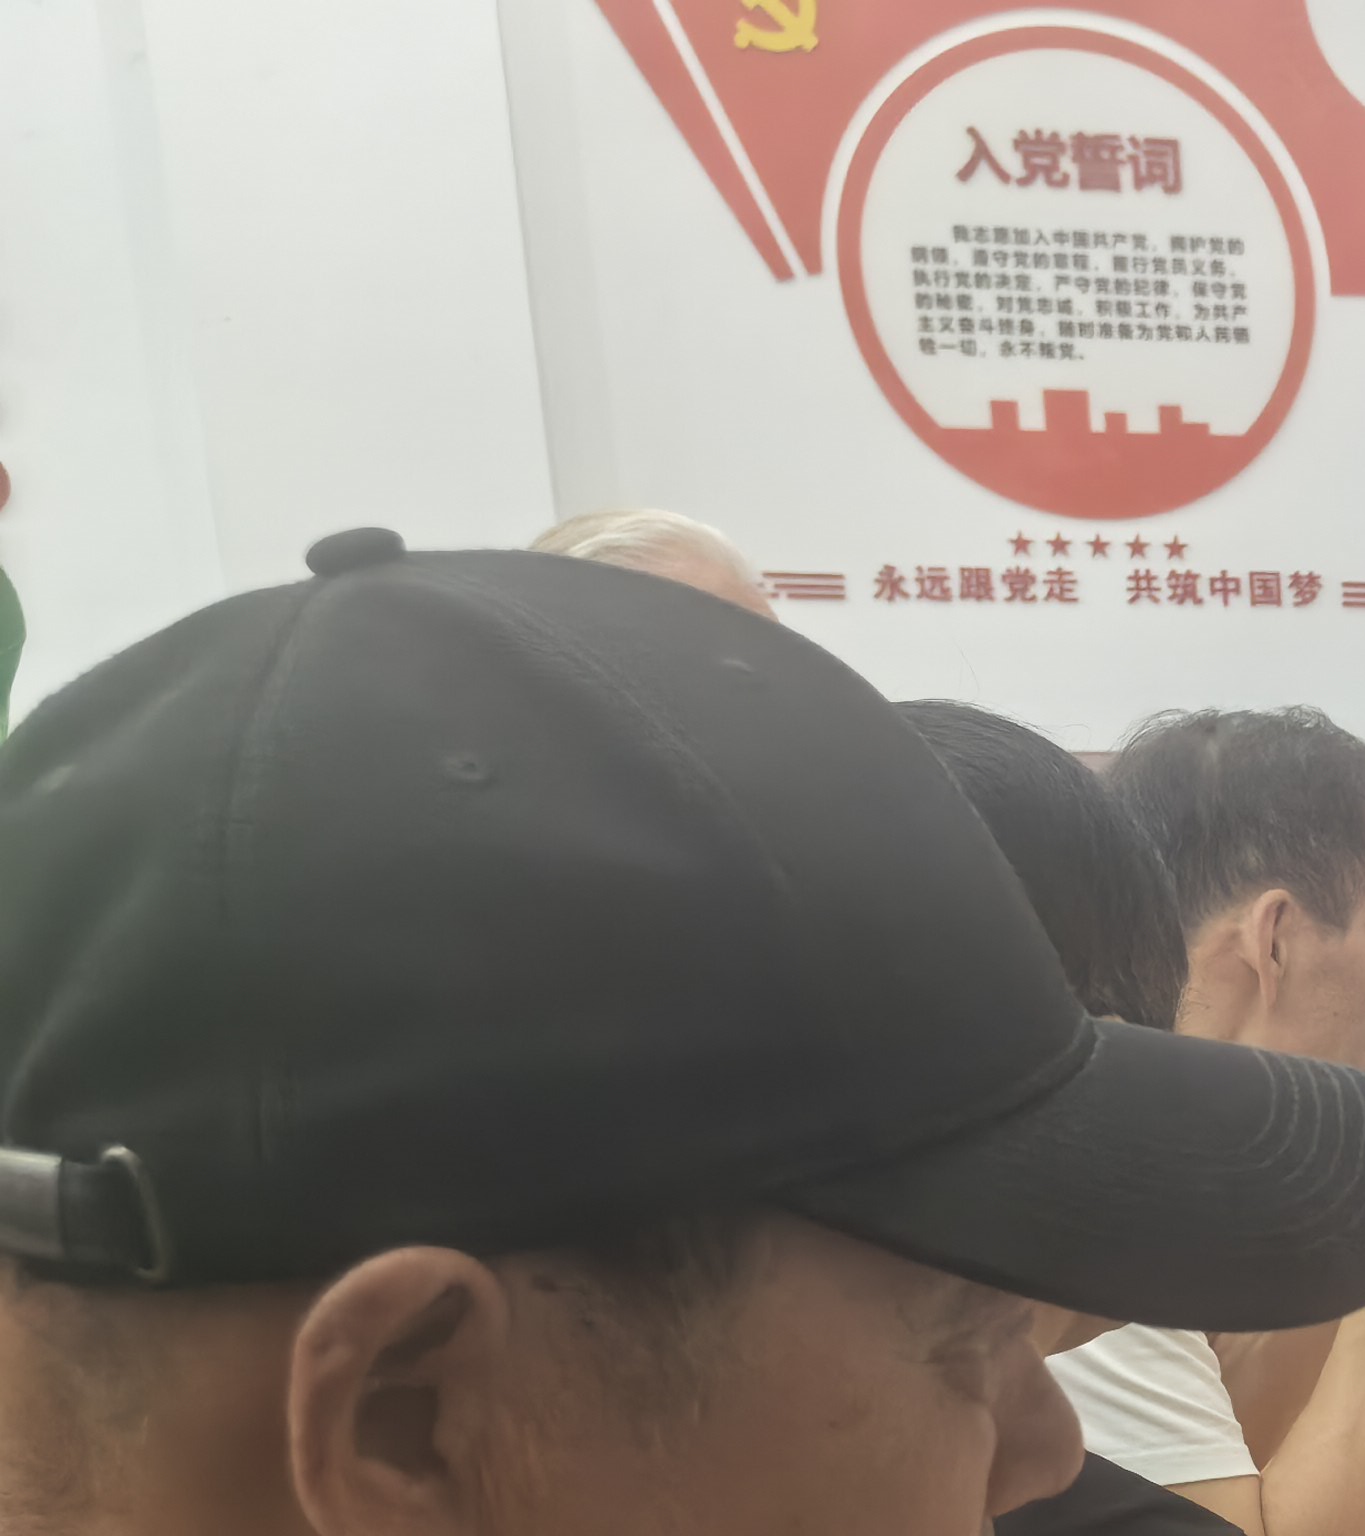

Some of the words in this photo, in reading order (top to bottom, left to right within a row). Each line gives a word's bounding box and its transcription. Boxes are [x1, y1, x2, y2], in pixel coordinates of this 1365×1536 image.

[955, 125, 1183, 195] 入党誓词
[873, 564, 1080, 604] 永远跟党走
[1125, 568, 1324, 608] 共筑中国梦
